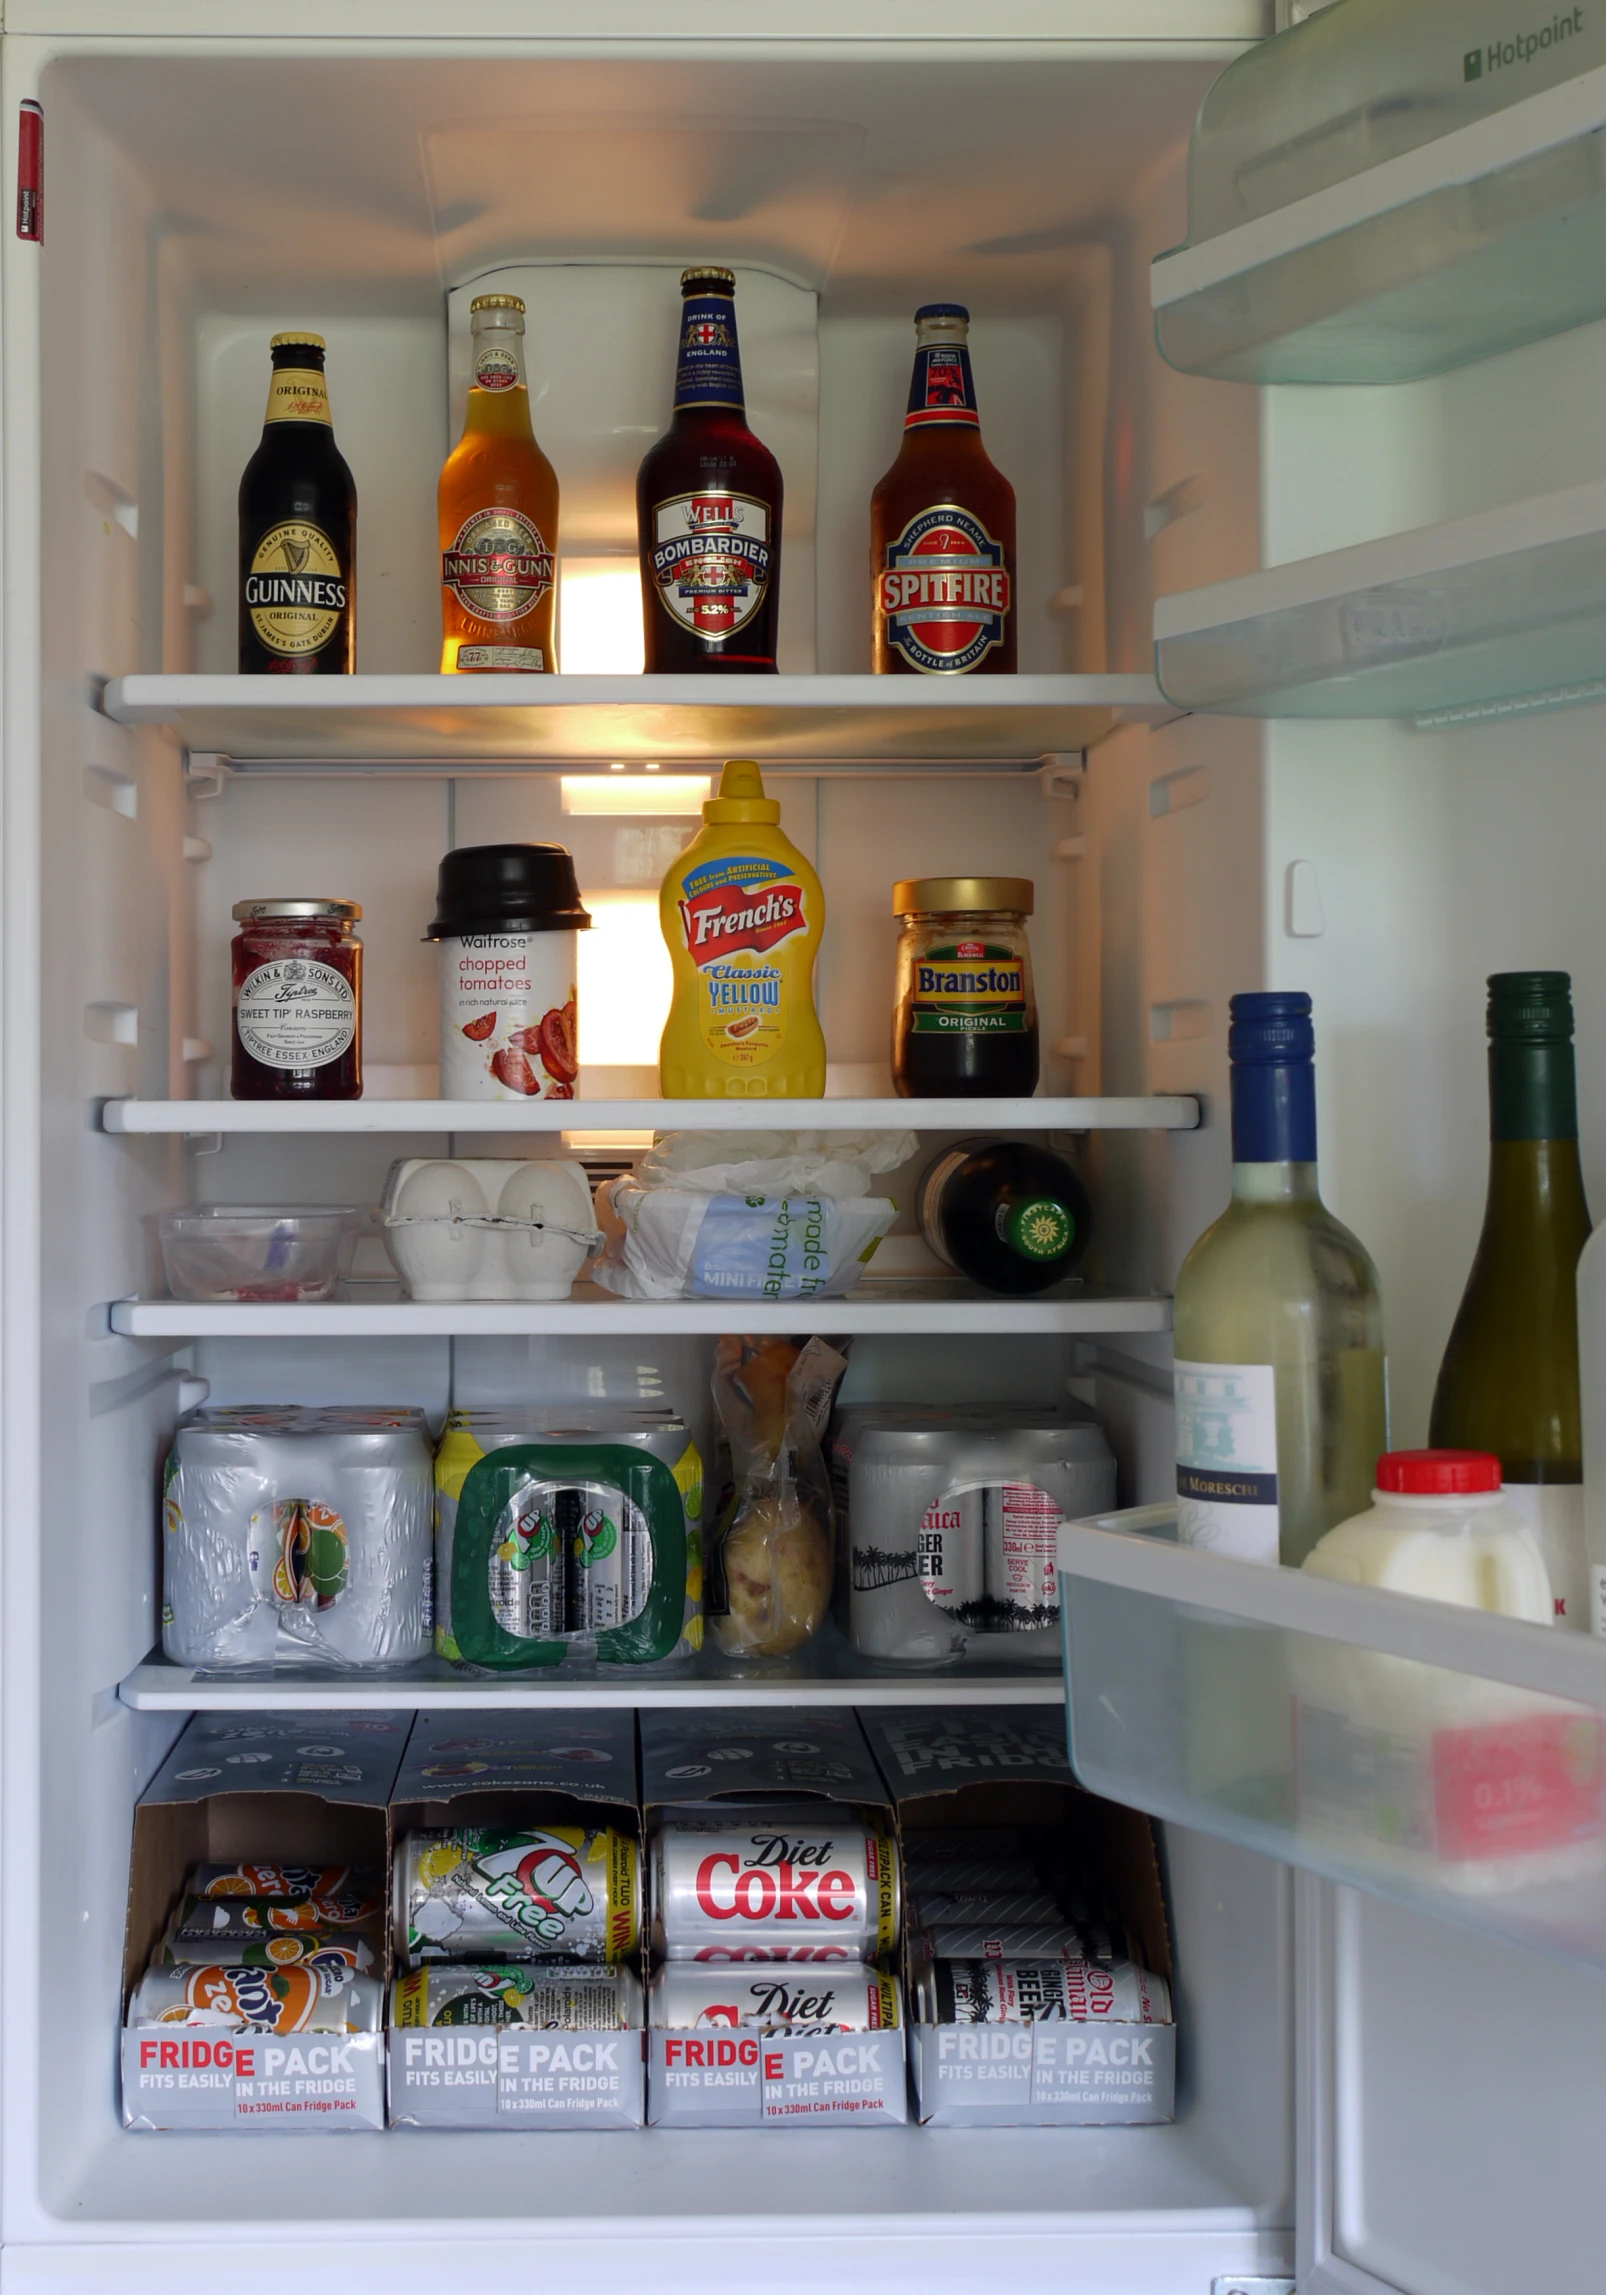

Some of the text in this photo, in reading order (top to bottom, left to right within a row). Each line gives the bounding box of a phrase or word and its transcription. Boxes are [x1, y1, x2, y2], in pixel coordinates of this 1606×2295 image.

[1488, 6, 1584, 72] Hotpoint
[22, 190, 30, 224] Hotpoint
[688, 313, 714, 322] DRINK
[686, 349, 728, 357] ENGLAND
[276, 386, 328, 400] ORIGINAL
[681, 506, 745, 524] WELLS
[467, 526, 482, 543] OAK
[513, 523, 532, 544] BEER
[903, 515, 987, 549] SHEPHERD NEAME
[259, 528, 334, 562] GENUINE QUALITY
[654, 536, 769, 569] BOMBARDIER
[444, 558, 553, 577] INNIS & GUNN
[685, 556, 743, 567] ENGLISH
[245, 576, 346, 608] GUINNESS
[480, 576, 518, 584] ORIGINAL
[884, 573, 1004, 609] SPITFIRE
[269, 611, 318, 621] ORIGINAL
[700, 604, 729, 615] 5.2%
[900, 611, 991, 622] KENTISH ALE
[260, 622, 287, 647] JAMES'S
[289, 639, 312, 648] GATE
[313, 617, 334, 641] DUBLIN
[910, 645, 944, 668] BOTTLE
[955, 634, 988, 666] BRITAIN
[689, 876, 707, 889] FREE
[727, 863, 770, 875] ARTIFICIAL
[689, 872, 777, 898] COLOURS and PRESERVATIVES
[693, 893, 794, 945] French's
[460, 934, 526, 949] Waitrose
[459, 956, 526, 976] chopped
[703, 965, 781, 979] Classic
[243, 968, 348, 1000] WILKIN & SONS LTD
[459, 976, 532, 991] tomatoes
[918, 967, 1021, 993] Branston
[275, 983, 319, 1003] Tiptree
[459, 998, 527, 1008] in rich natural juice
[709, 980, 778, 1007] YELLOW
[240, 1009, 269, 1019] SWEET
[295, 1009, 353, 1020] RASPBERRY
[938, 1016, 1007, 1027] ORIGINAL
[244, 1030, 348, 1060] TIPTREE ESSEX ENGLAND
[804, 1201, 828, 1271] made
[1021, 1231, 1069, 1255] SOUTH AFRICA
[704, 1271, 744, 1287] MINI
[1190, 1476, 1259, 1497] MORESCHI
[1004, 1541, 1022, 1552] 330ml
[1007, 1558, 1030, 1566] SERVE
[1008, 1565, 1028, 1573] COOL
[900, 1754, 1070, 1776] FRIDG
[421, 1779, 606, 1790] www.cokezone.co.uk
[744, 1834, 834, 1867] Diet
[866, 1839, 874, 1858] SUGAR
[620, 1879, 631, 1906] TWO
[696, 1853, 856, 1920] Coke
[452, 1874, 551, 1950] Natural Lemon and Lime Flavour
[485, 1873, 565, 1940] Free
[880, 1891, 891, 1918] CAN
[612, 1910, 631, 1951] WIN
[221, 1964, 283, 2026] Fant
[750, 1982, 836, 2019] Diet
[868, 1986, 876, 2007] SUGAR
[1006, 1990, 1016, 2008] Fiery
[1016, 1969, 1041, 2017] BEER
[1056, 1959, 1089, 2020] Jamai
[1087, 1969, 1114, 2014] Old
[140, 2040, 354, 2077] FRIDGE PACK
[405, 2037, 619, 2074] FRIDGE PACK
[665, 2039, 882, 2081] FRIDGE PACK
[938, 2031, 1154, 2066] FRIDGE PACK
[140, 2073, 356, 2097] FITS EASILY IN THE FRIDGE
[406, 2070, 620, 2093] FITS EASILY IN THE FRIDGE
[665, 2071, 884, 2100] FITS EASILY IN THE FRIDGE
[938, 2064, 1153, 2085] FITS EASILY IN THE FRIDGE
[238, 2099, 356, 2114] 10 x 330ml Can Fridge Pack
[501, 2097, 620, 2110] 10 x 330ml Can Fridge Pack
[767, 2098, 884, 2116] 10 x 330ml Can Fridge Pack
